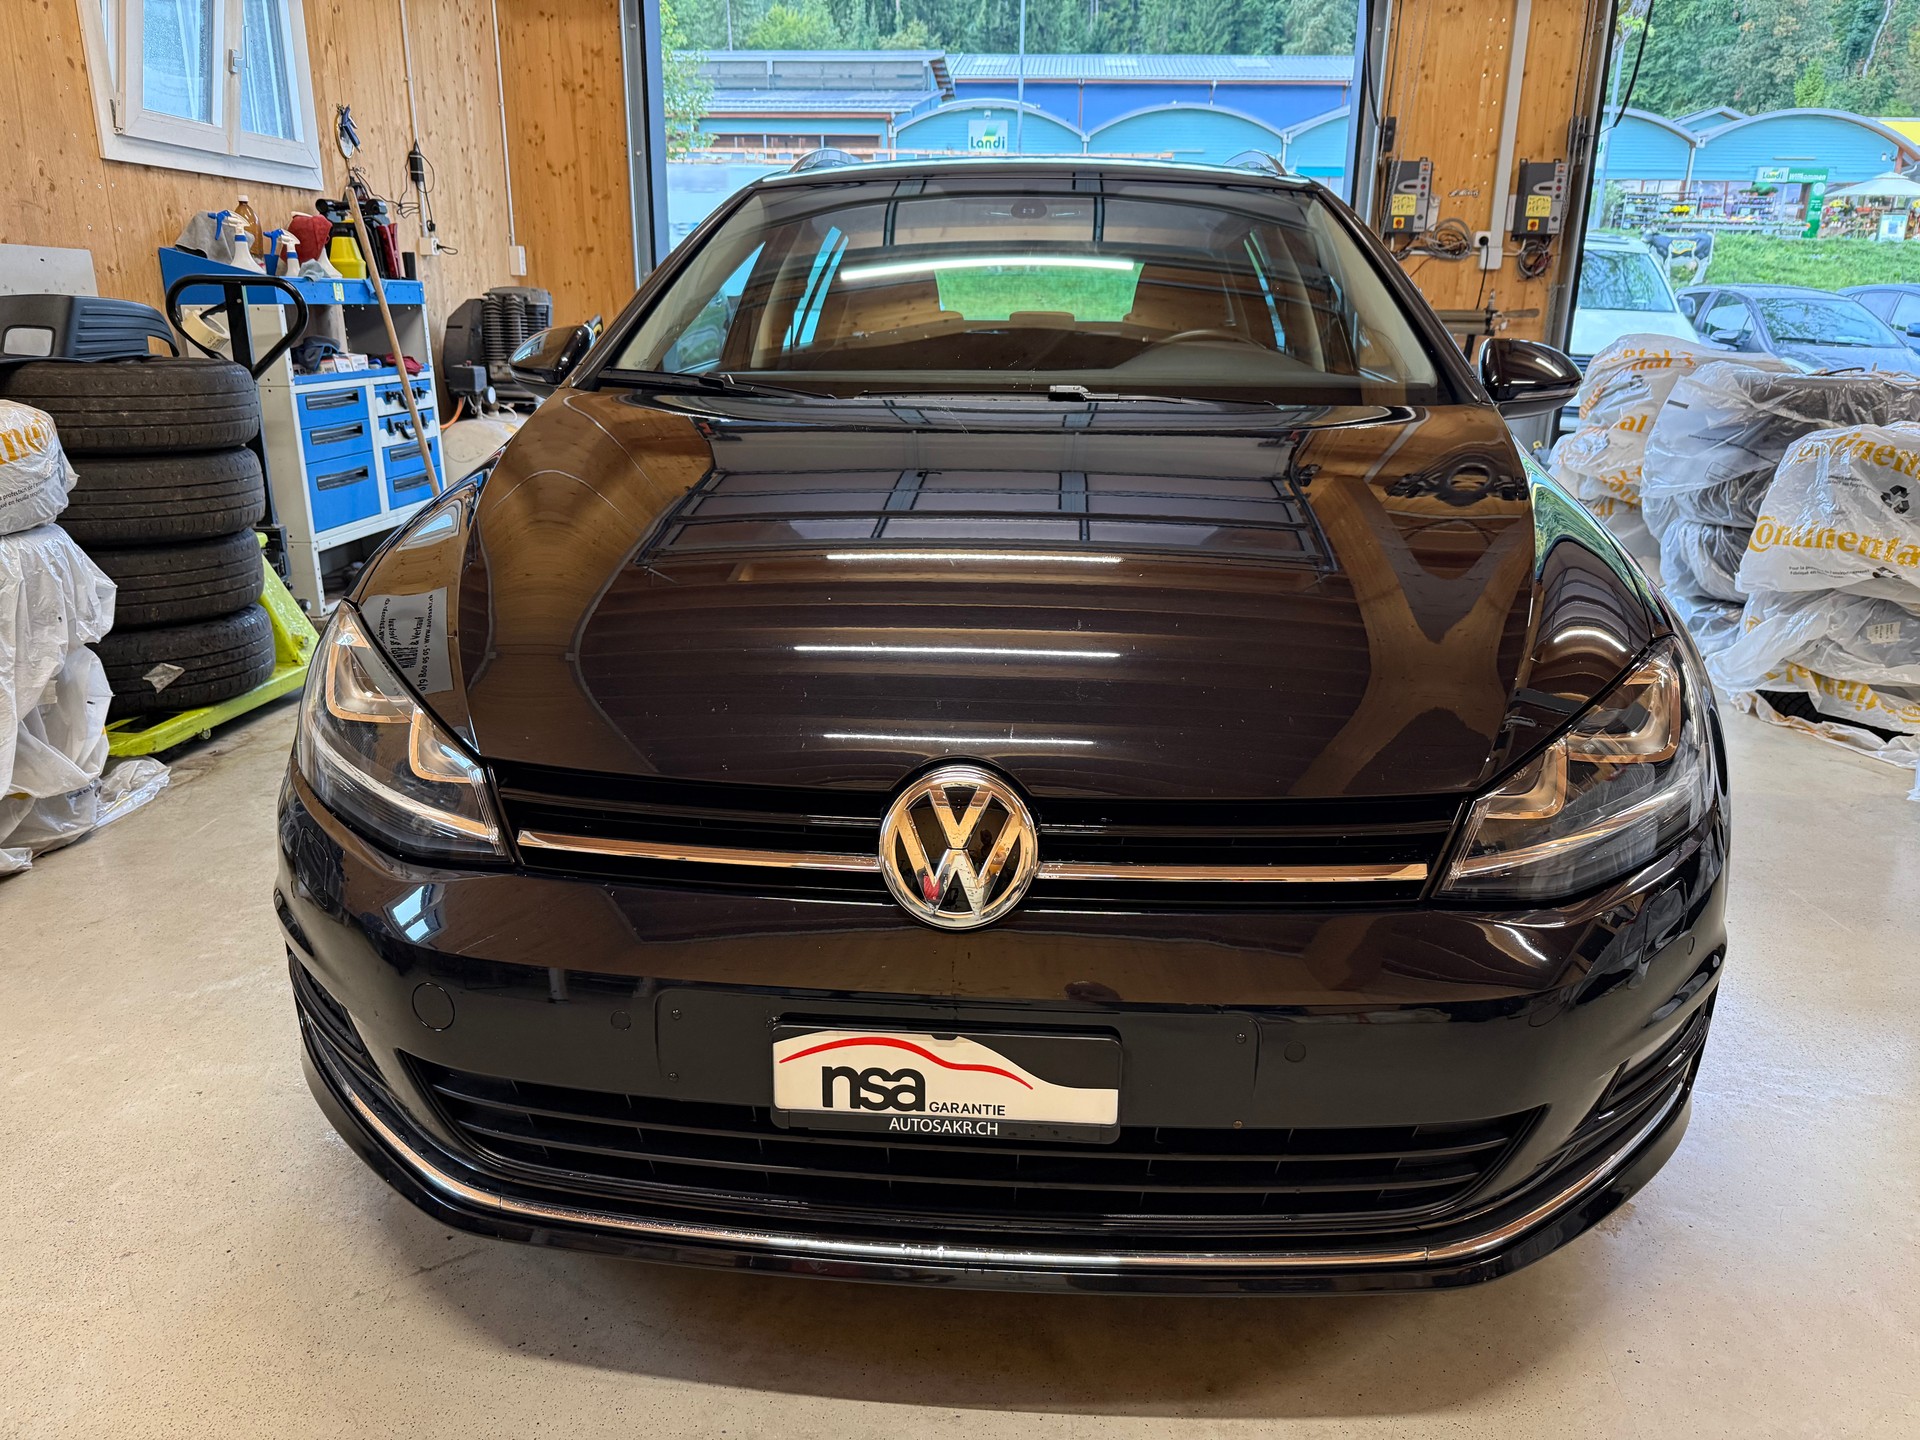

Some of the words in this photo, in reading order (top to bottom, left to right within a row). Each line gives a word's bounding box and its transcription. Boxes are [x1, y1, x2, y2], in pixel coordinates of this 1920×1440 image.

[970, 136, 1005, 149] Landi
[821, 1065, 926, 1112] nsa
[929, 1101, 1006, 1116] GARANTIE
[888, 1117, 999, 1136] AUTOSAKR.CH
